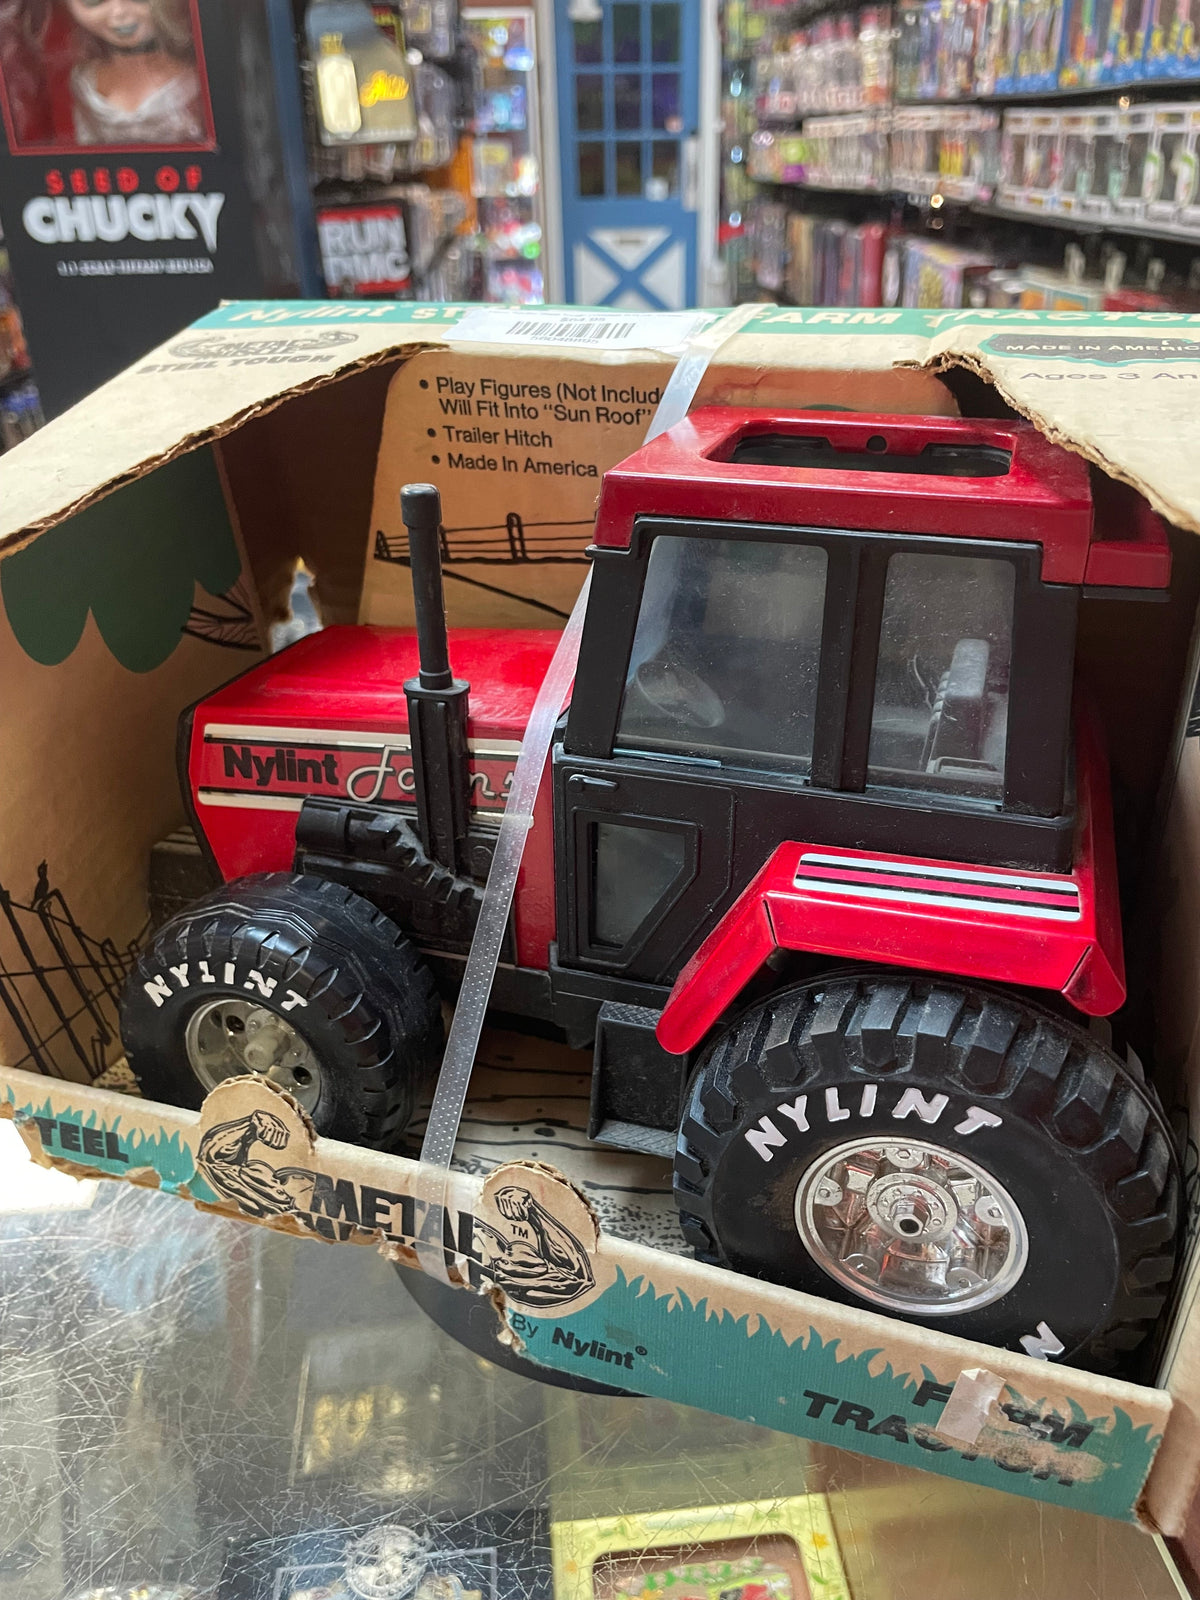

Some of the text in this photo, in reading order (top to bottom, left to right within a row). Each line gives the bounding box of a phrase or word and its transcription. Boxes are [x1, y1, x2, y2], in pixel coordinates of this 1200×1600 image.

[45, 165, 202, 195] SEED OF
[22, 192, 225, 253] CHUCKY
[319, 215, 406, 254] RUN
[227, 305, 396, 323] Nylint
[754, 311, 903, 325] ARM
[228, 345, 336, 367] TOUGH
[436, 376, 665, 404] Play Figures (Not Includ
[1019, 372, 1199, 380] Ages 3 An
[439, 398, 472, 416] Will
[477, 400, 501, 418] Fit
[504, 402, 539, 420] Into
[443, 425, 553, 448] Trailer Hitch
[448, 453, 599, 477] Made In America
[223, 745, 339, 787] Nylint
[143, 960, 309, 1011] NYLINT
[14, 1110, 130, 1164] TEEL
[744, 1083, 1003, 1163] NYLINT
[310, 1172, 484, 1265] METAL
[510, 1223, 530, 1240] TM
[511, 1312, 539, 1339] By
[911, 1379, 1095, 1448] FRM
